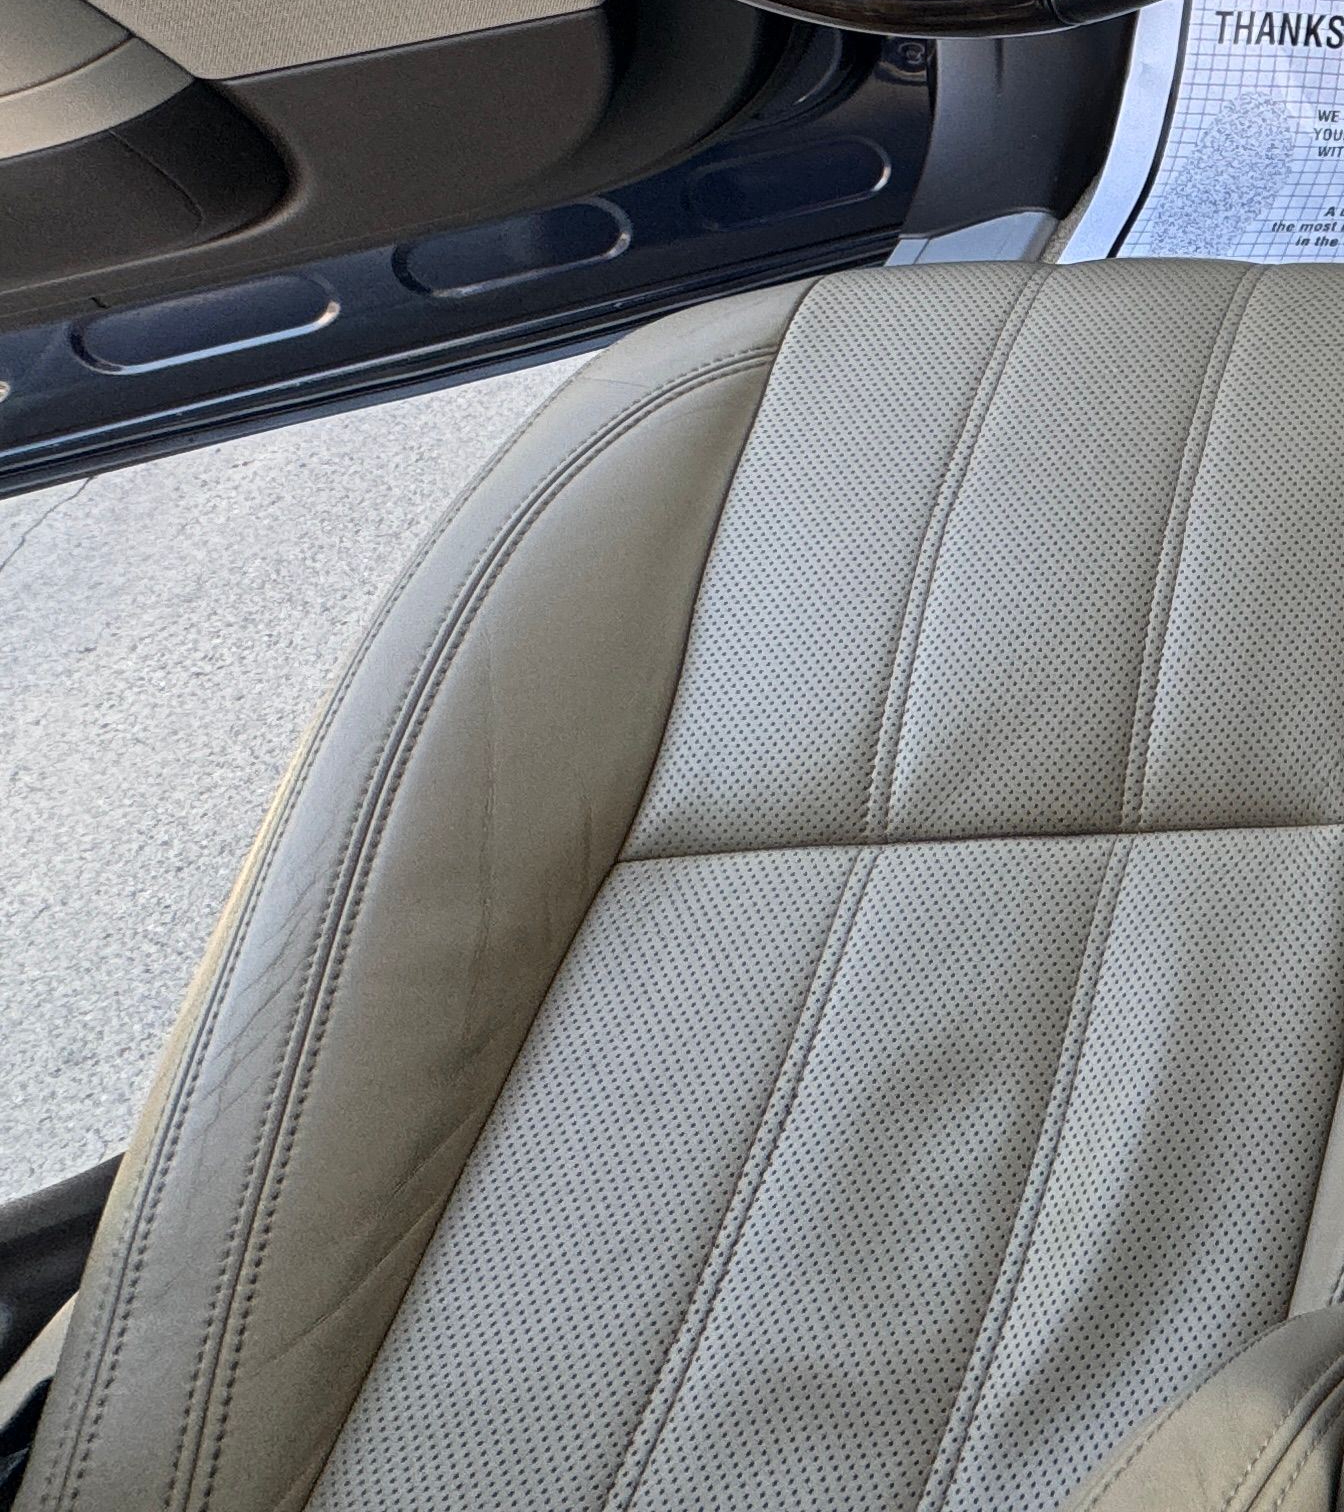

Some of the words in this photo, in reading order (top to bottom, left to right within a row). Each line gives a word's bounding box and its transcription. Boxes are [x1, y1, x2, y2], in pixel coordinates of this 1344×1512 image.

[1215, 10, 1344, 50] THANKS
[1318, 110, 1340, 123] WE
[1323, 206, 1335, 217] A
[1272, 221, 1296, 233] the
[1300, 221, 1337, 233] most
[1295, 236, 1311, 247] in
[1314, 236, 1338, 247] the
